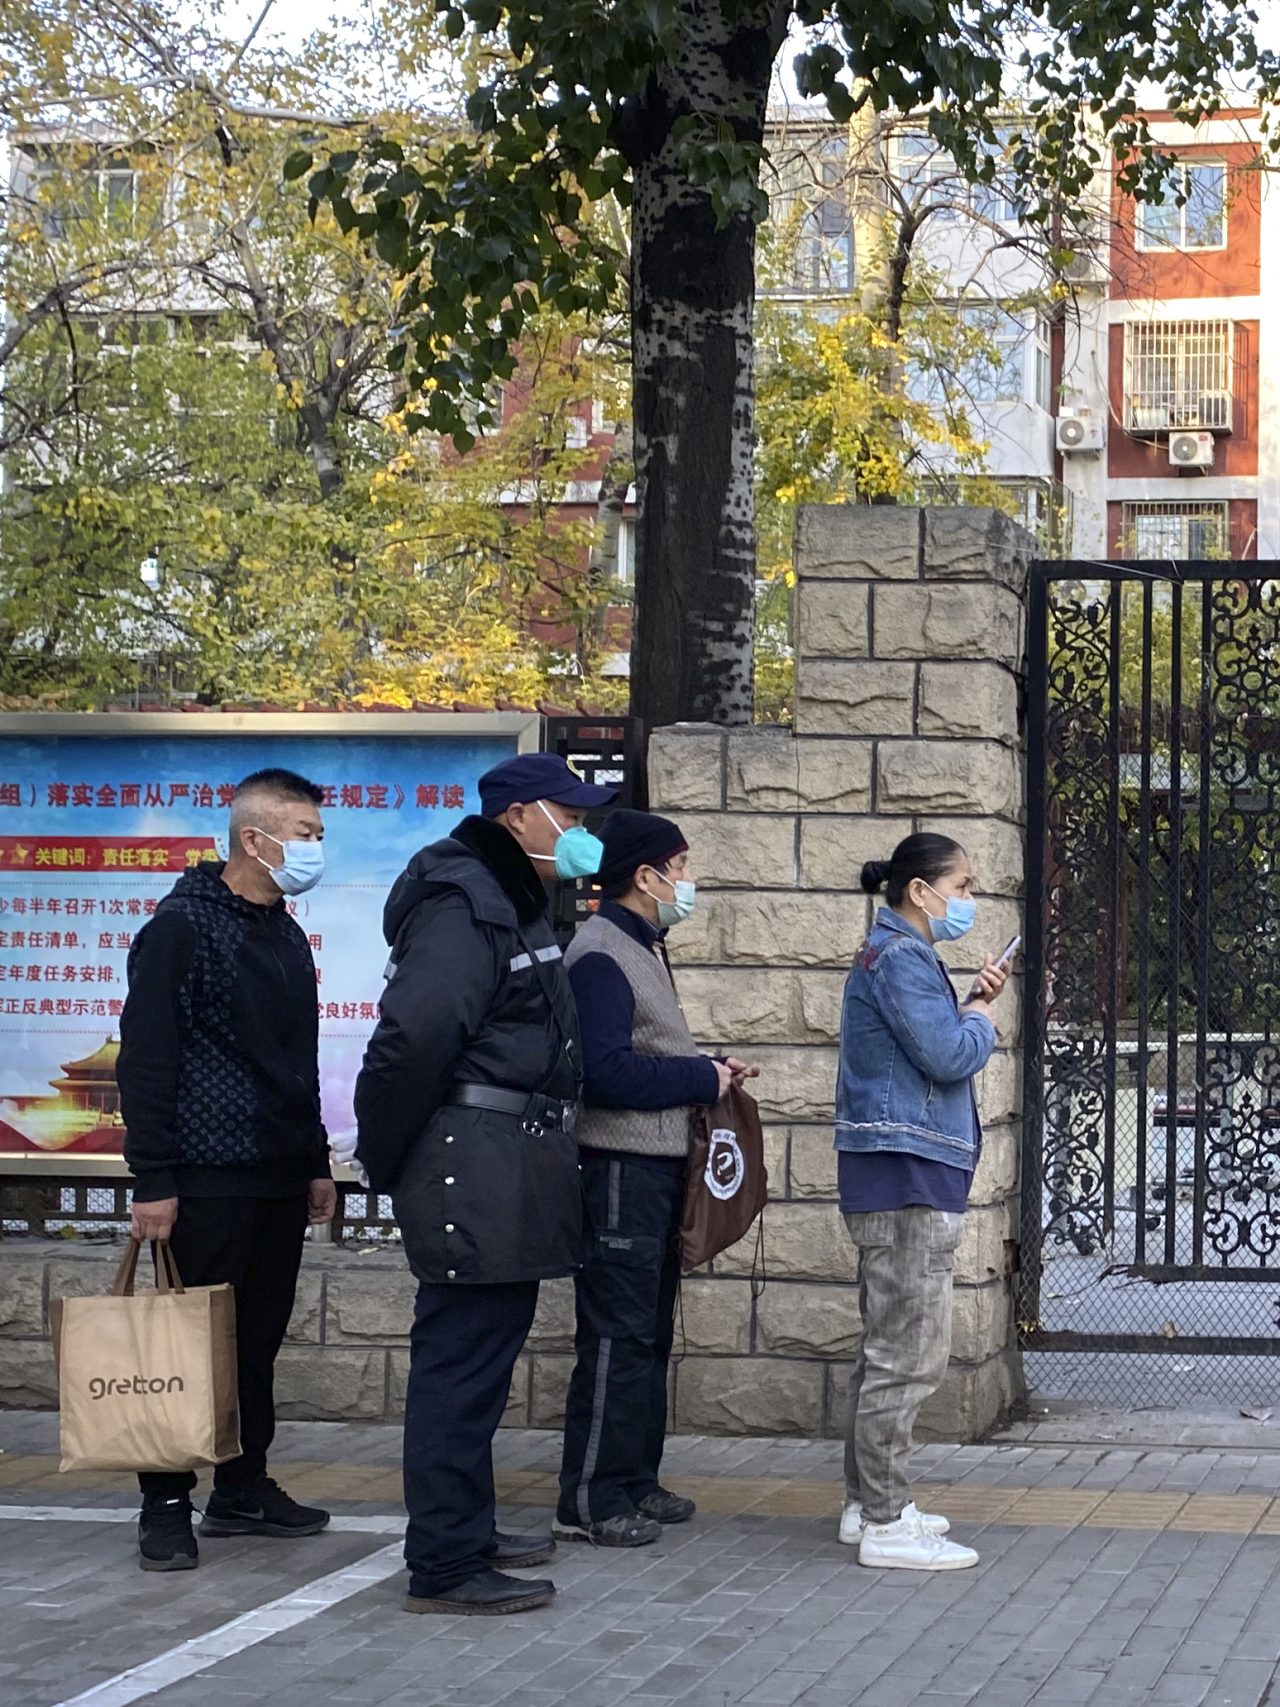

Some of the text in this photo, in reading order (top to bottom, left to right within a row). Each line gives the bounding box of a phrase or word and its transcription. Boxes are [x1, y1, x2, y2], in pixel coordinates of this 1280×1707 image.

[0, 998, 381, 1020] 正反典型示范警 良好氛
